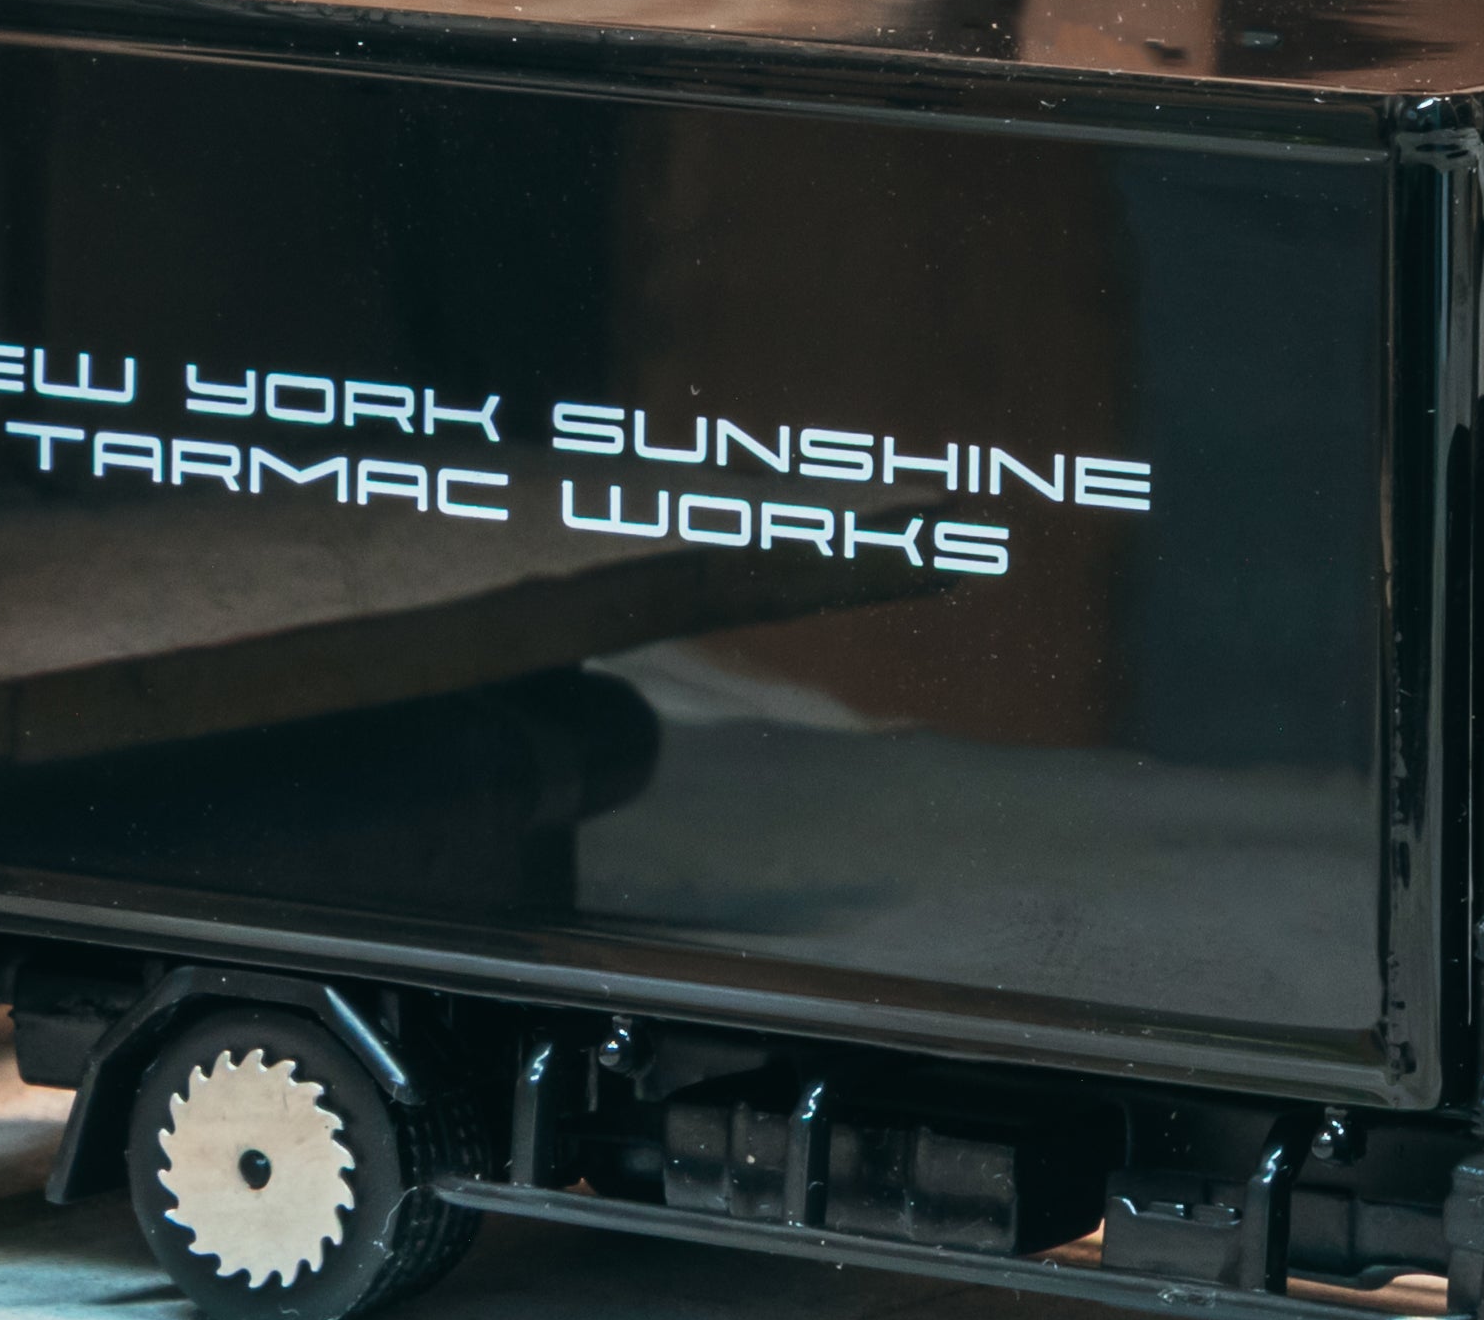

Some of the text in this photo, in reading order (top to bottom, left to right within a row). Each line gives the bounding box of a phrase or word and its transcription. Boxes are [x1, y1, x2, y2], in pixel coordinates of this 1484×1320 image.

[6, 421, 1010, 576] TARMAC WORKS
[186, 364, 501, 442] YORK
[552, 402, 1151, 511] SUNSHINE
